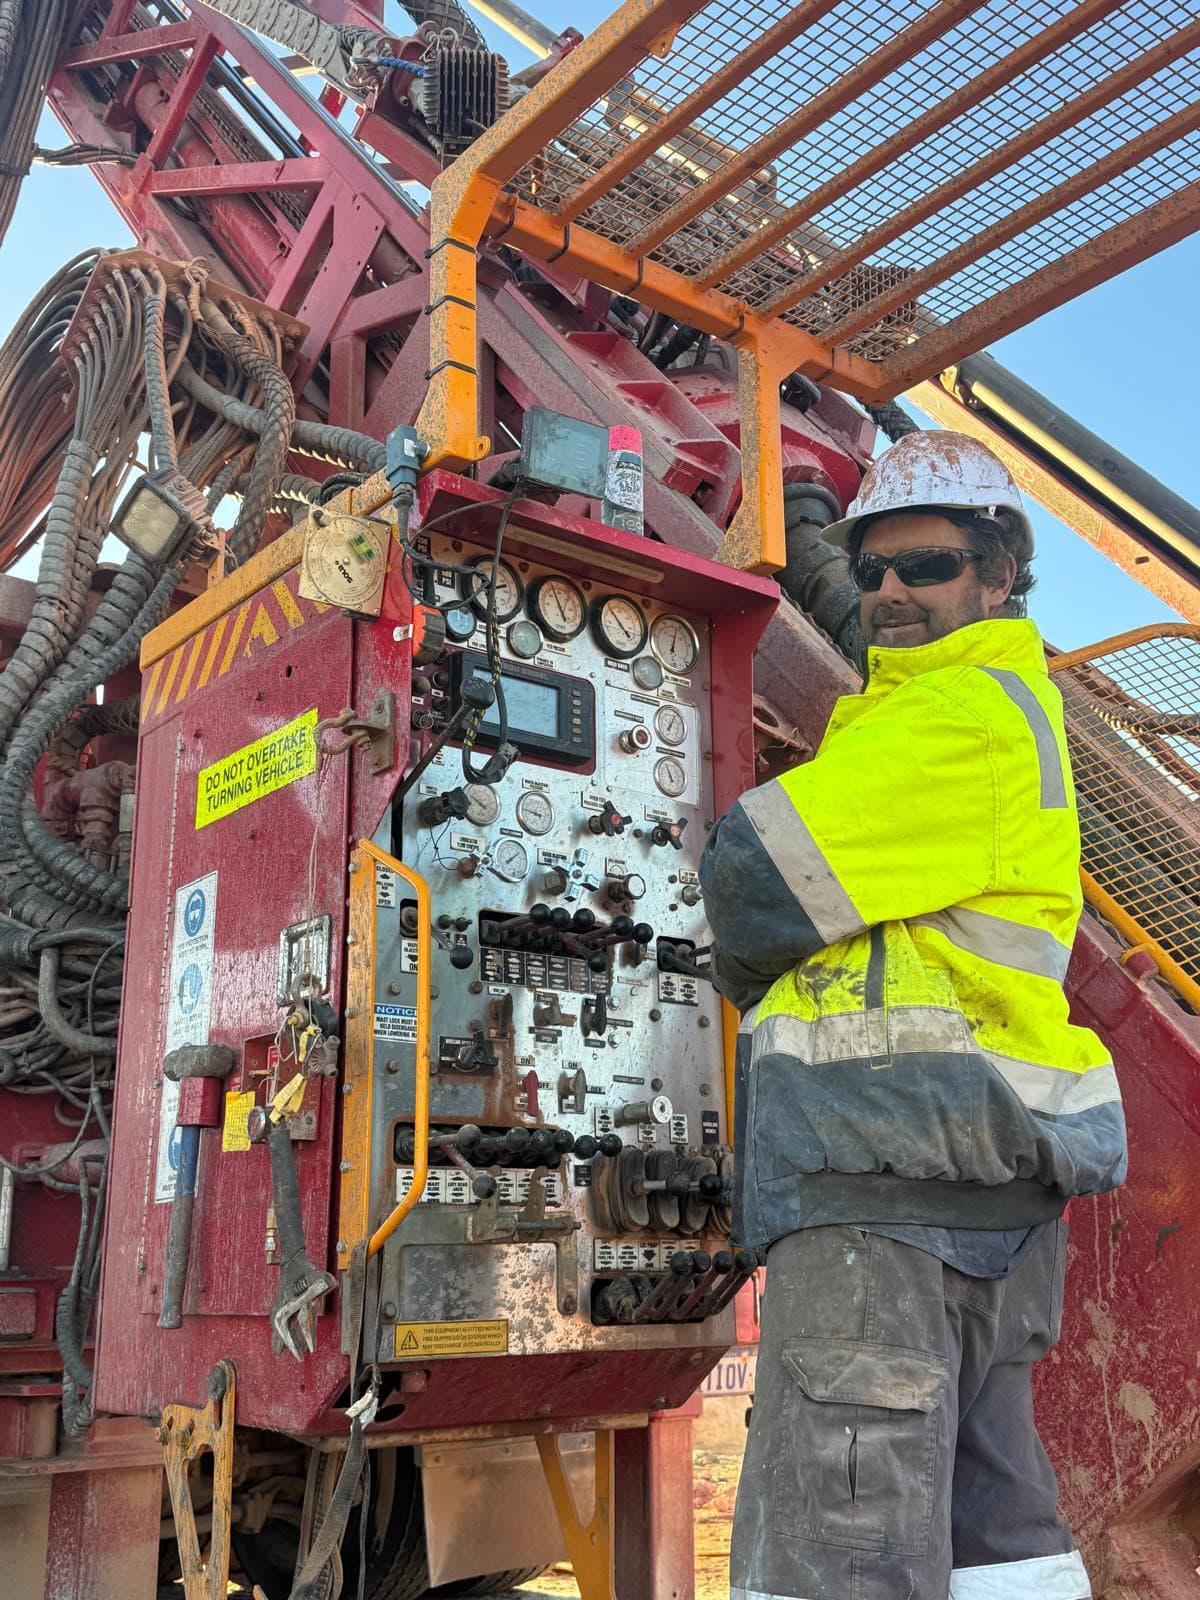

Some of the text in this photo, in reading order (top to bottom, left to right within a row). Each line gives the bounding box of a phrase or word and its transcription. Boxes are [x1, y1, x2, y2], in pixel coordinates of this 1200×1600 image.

[206, 727, 306, 793] DO NOT OVERTAKE
[207, 750, 303, 812] TURNING VEHICLE
